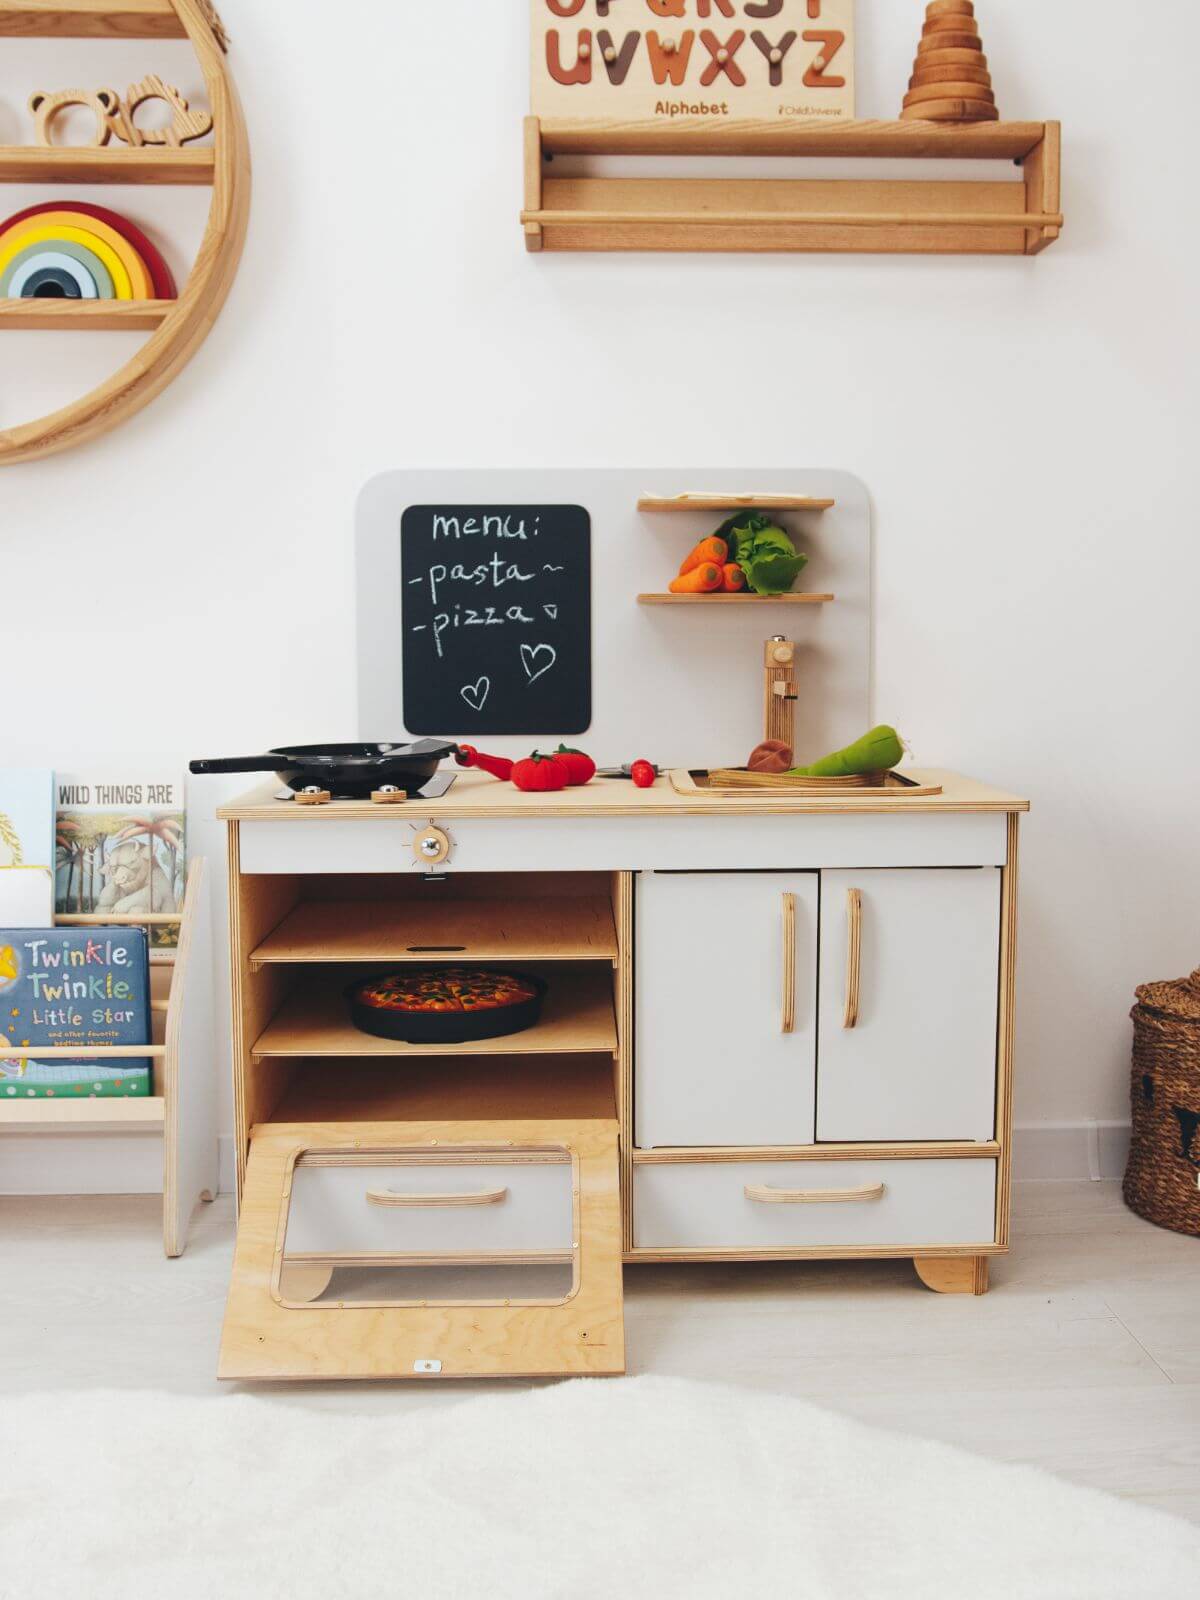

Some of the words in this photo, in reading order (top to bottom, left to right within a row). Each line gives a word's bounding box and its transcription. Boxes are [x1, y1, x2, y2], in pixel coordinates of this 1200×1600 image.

[655, 101, 729, 116] Alphabet
[432, 514, 540, 540] menu:
[59, 785, 90, 805] WILD
[95, 785, 142, 805] THINGS
[147, 784, 173, 804] ARE
[24, 939, 133, 968] Twinkle,
[32, 1006, 83, 1026] Little
[64, 1030, 85, 1038] other
[87, 1030, 120, 1038] favorite
